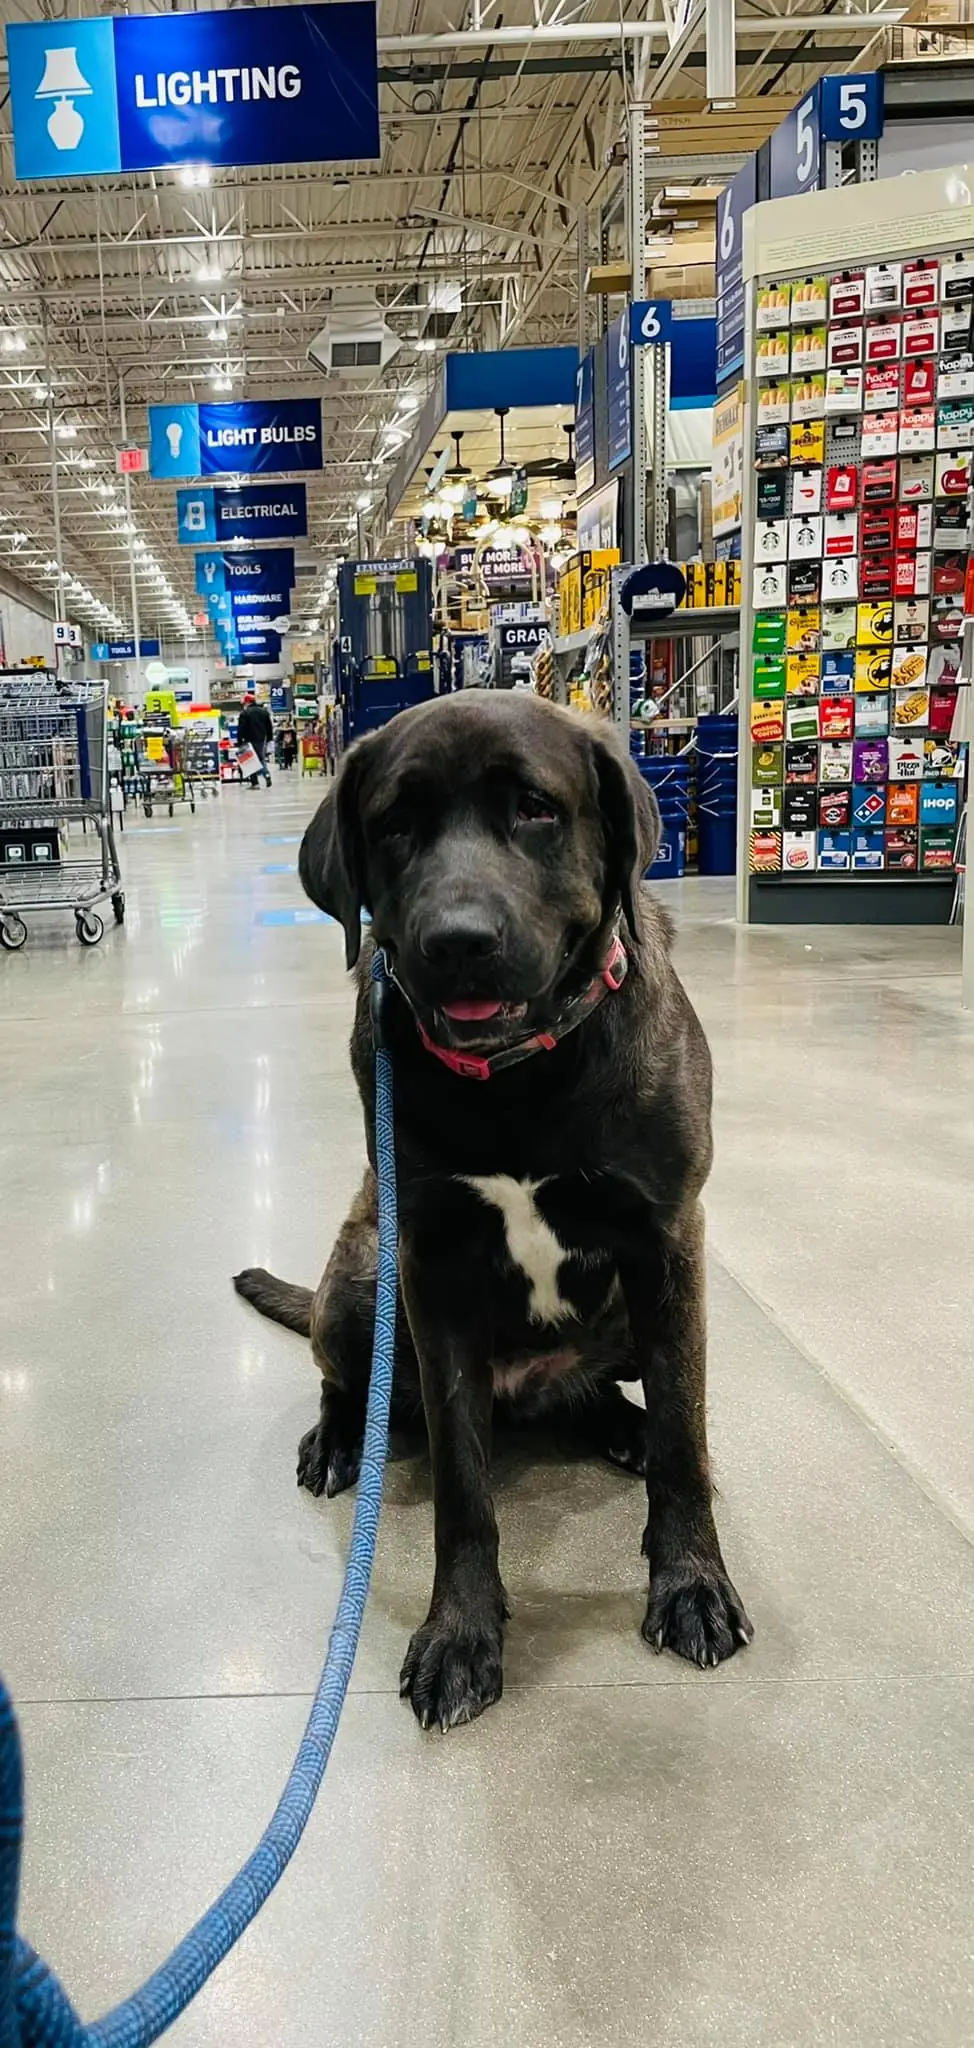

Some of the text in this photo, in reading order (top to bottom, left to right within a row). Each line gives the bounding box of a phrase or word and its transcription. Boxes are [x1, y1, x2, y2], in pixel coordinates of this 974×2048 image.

[135, 65, 301, 108] LIGHTING
[839, 84, 866, 129] 5
[796, 96, 813, 182] 5
[720, 188, 734, 260] 6
[641, 307, 661, 337] 6
[866, 369, 899, 385] happy
[902, 412, 934, 425] happy
[940, 407, 973, 421] happy
[863, 415, 898, 430] happy
[207, 425, 316, 447] LIGHT BULBS
[221, 504, 298, 520] ELECTRICAL
[230, 564, 262, 575] TOOLS
[493, 562, 525, 574] MORE
[234, 593, 282, 605] HARDWARE
[57, 627, 64, 638] 9
[506, 628, 548, 644] GRAB
[111, 646, 132, 654] TOOLS
[343, 638, 350, 651] 4
[272, 688, 283, 697] 20
[923, 798, 955, 811] IHOP
